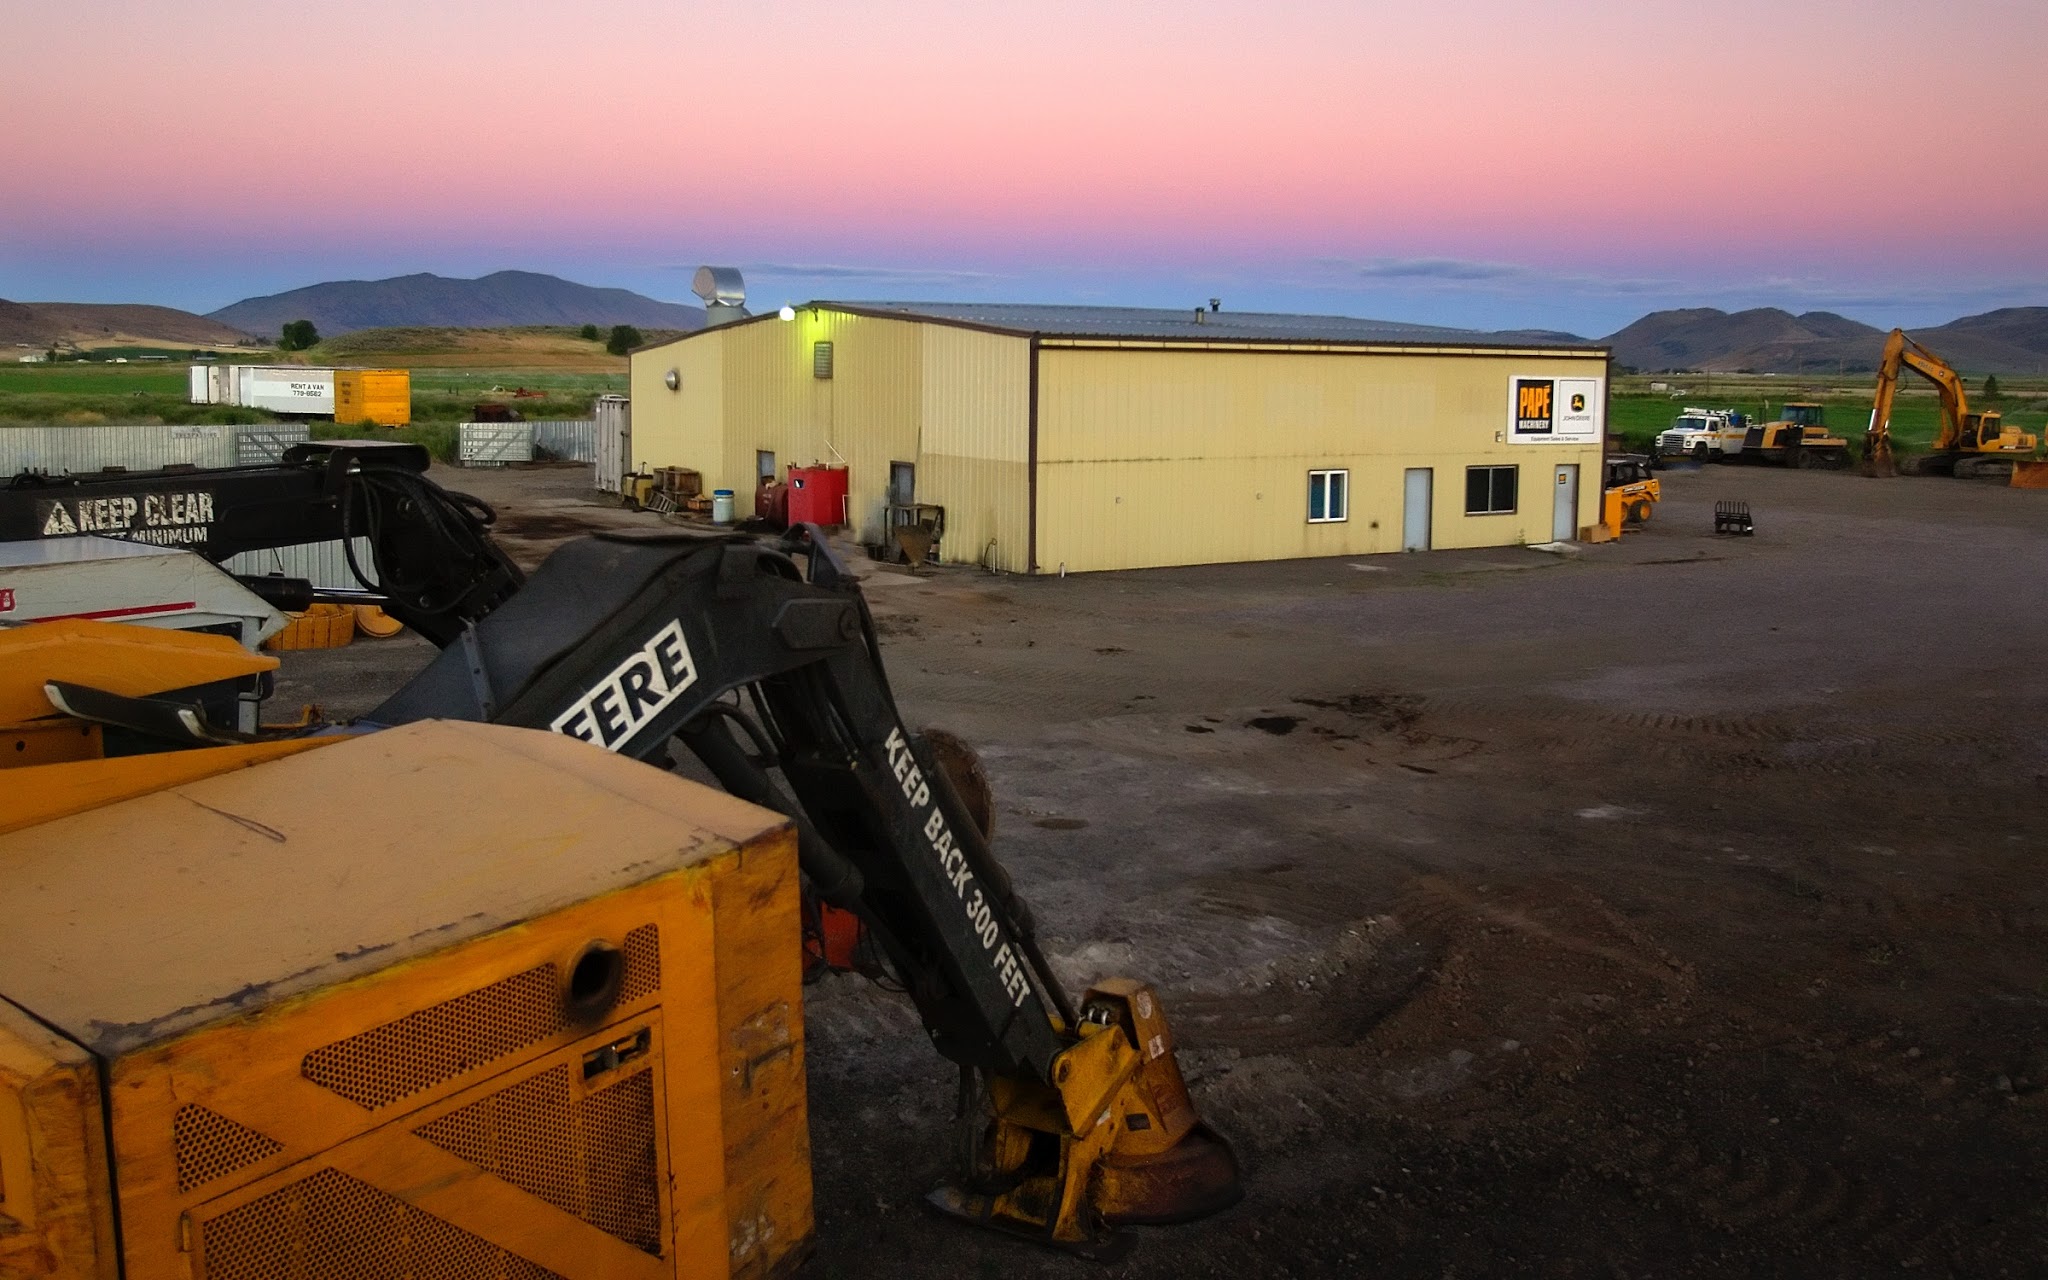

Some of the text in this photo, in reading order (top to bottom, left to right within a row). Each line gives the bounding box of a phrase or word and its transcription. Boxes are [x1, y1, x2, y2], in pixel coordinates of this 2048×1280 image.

[1519, 385, 1551, 418] PAPÉ
[79, 492, 215, 532] KEEP CLEAR
[132, 526, 208, 546] MINIMUM
[560, 630, 689, 748] EERE
[885, 726, 1031, 1007] KEEP BACK 300 FEET
